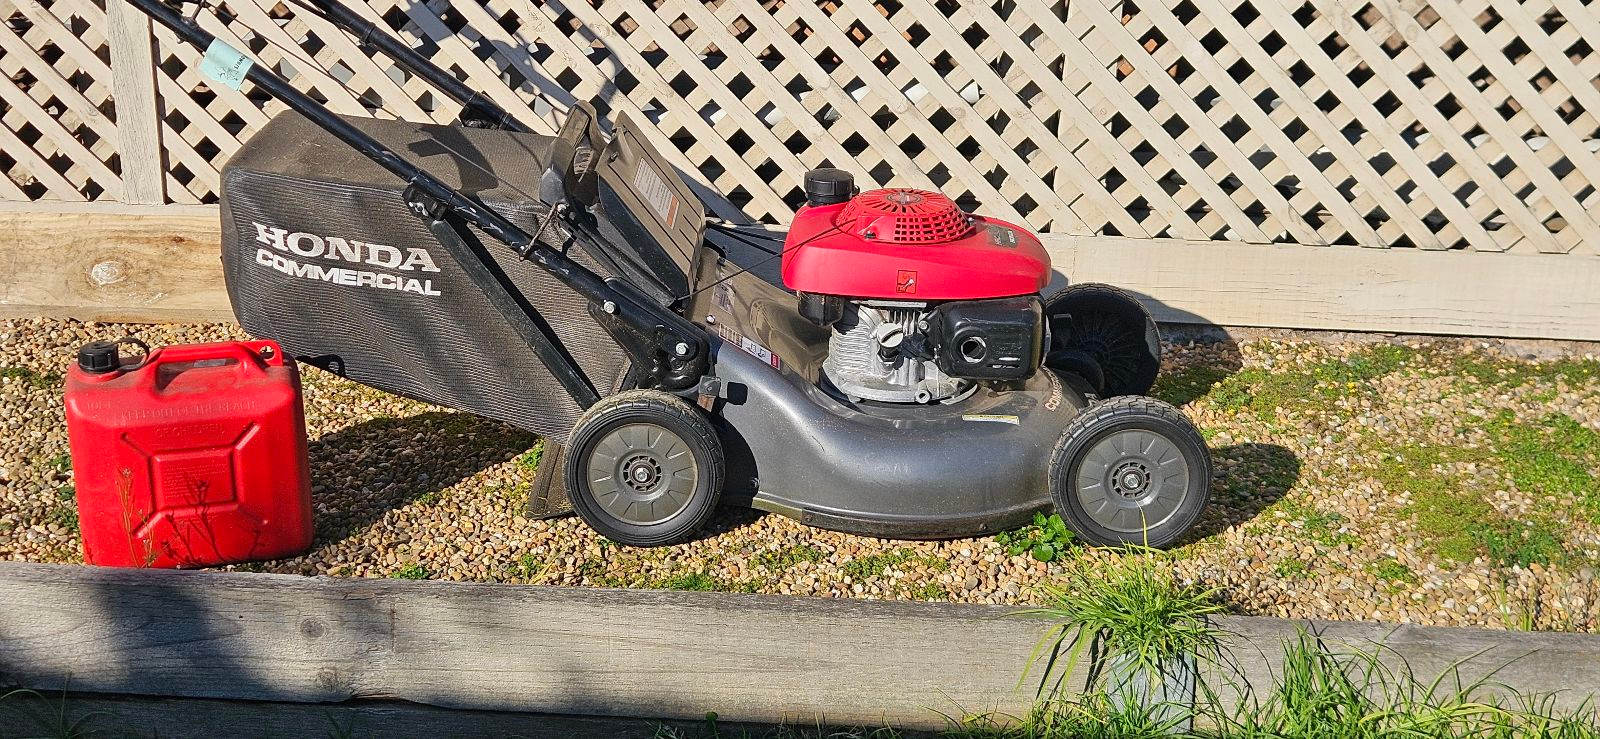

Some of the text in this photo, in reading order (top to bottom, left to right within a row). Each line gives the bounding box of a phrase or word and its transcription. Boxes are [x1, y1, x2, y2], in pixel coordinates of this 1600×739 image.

[252, 221, 441, 273] HONDA
[256, 248, 441, 297] COMMERCIAL
[121, 408, 149, 419] KEEP
[151, 408, 174, 417] OUT
[219, 401, 257, 412] REACH
